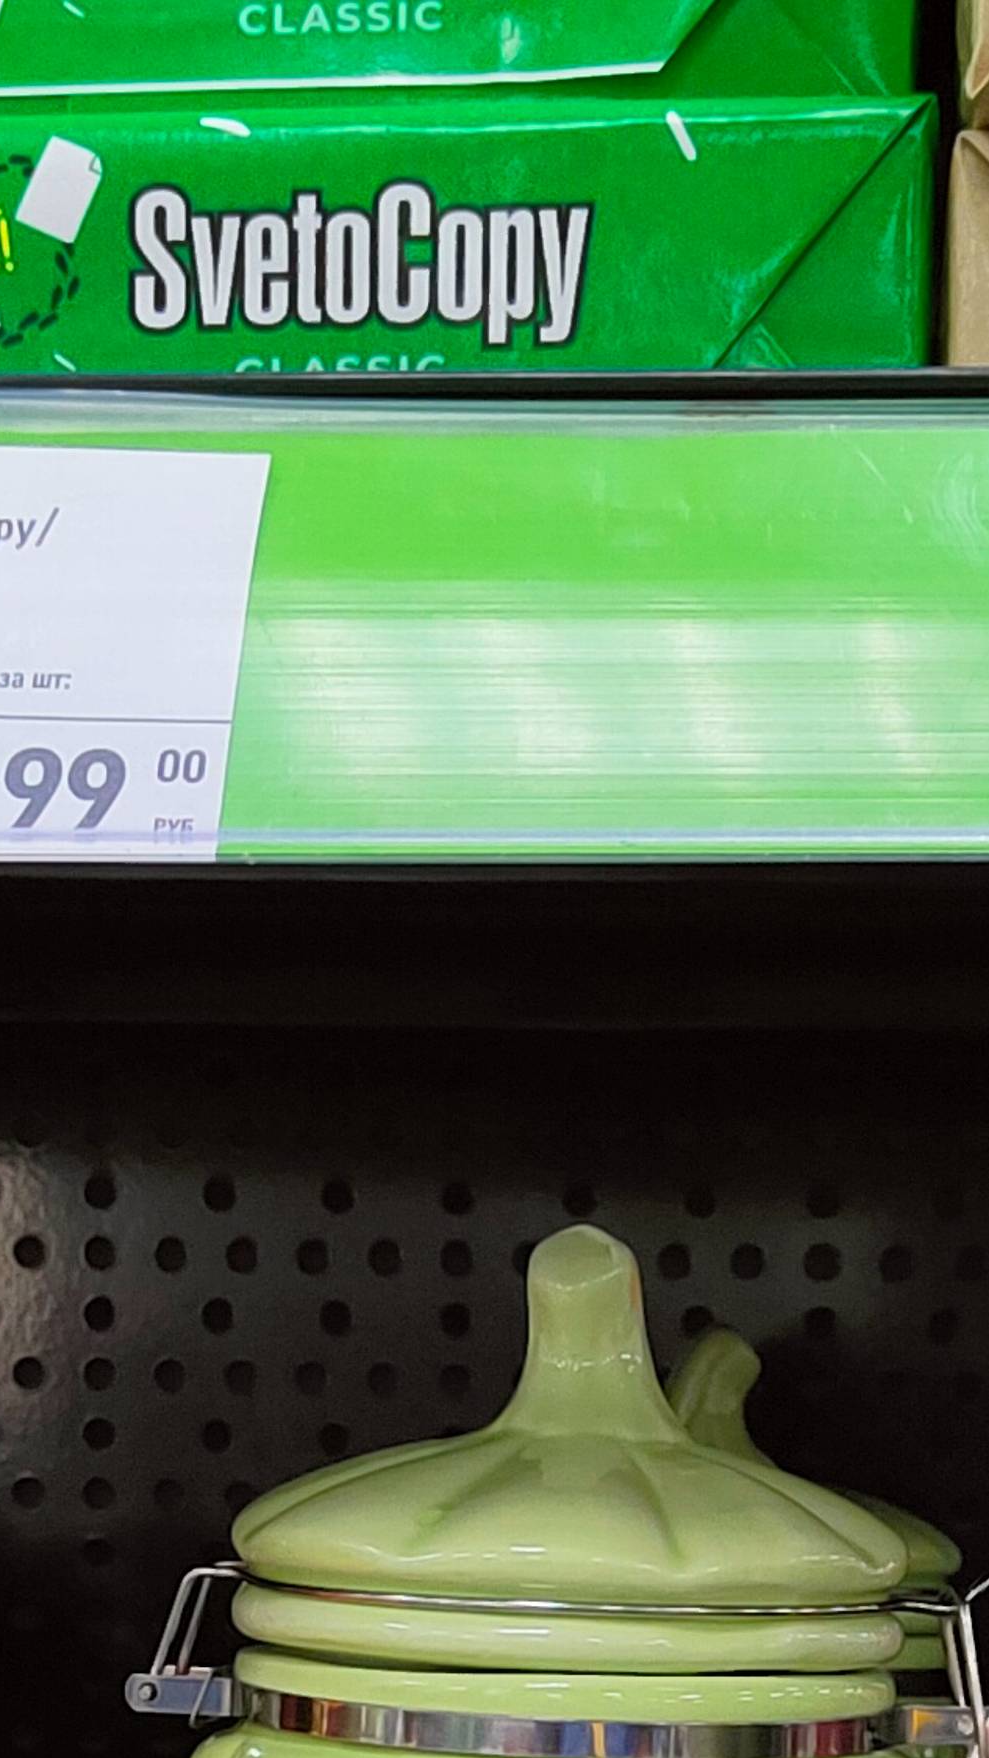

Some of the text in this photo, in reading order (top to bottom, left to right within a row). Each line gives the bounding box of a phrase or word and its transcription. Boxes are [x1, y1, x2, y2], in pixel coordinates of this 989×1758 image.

[238, 0, 443, 35] CLASSIC
[131, 180, 593, 348] SvetoCopy
[32, 671, 72, 691] шт:
[155, 748, 208, 784] 00
[154, 817, 194, 838] РУБ
